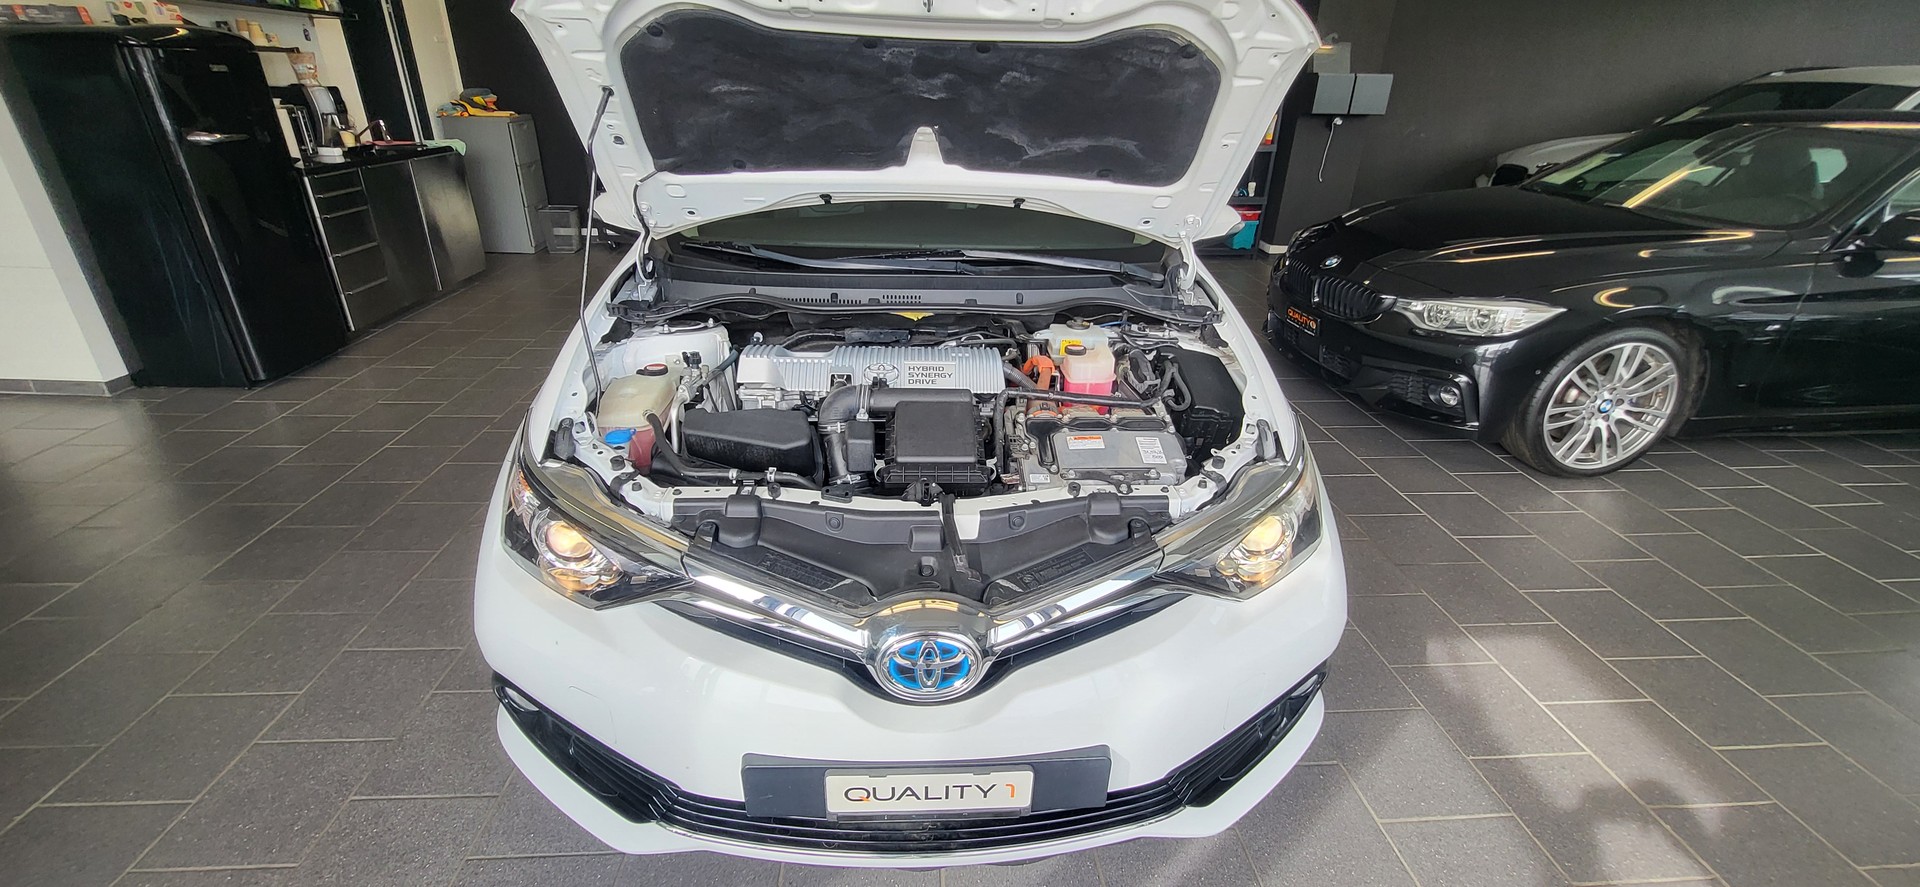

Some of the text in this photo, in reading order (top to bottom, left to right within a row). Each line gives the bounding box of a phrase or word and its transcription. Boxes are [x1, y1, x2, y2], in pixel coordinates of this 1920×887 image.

[1287, 308, 1311, 327] QUALITY
[844, 783, 1016, 802] QUALITY 1
